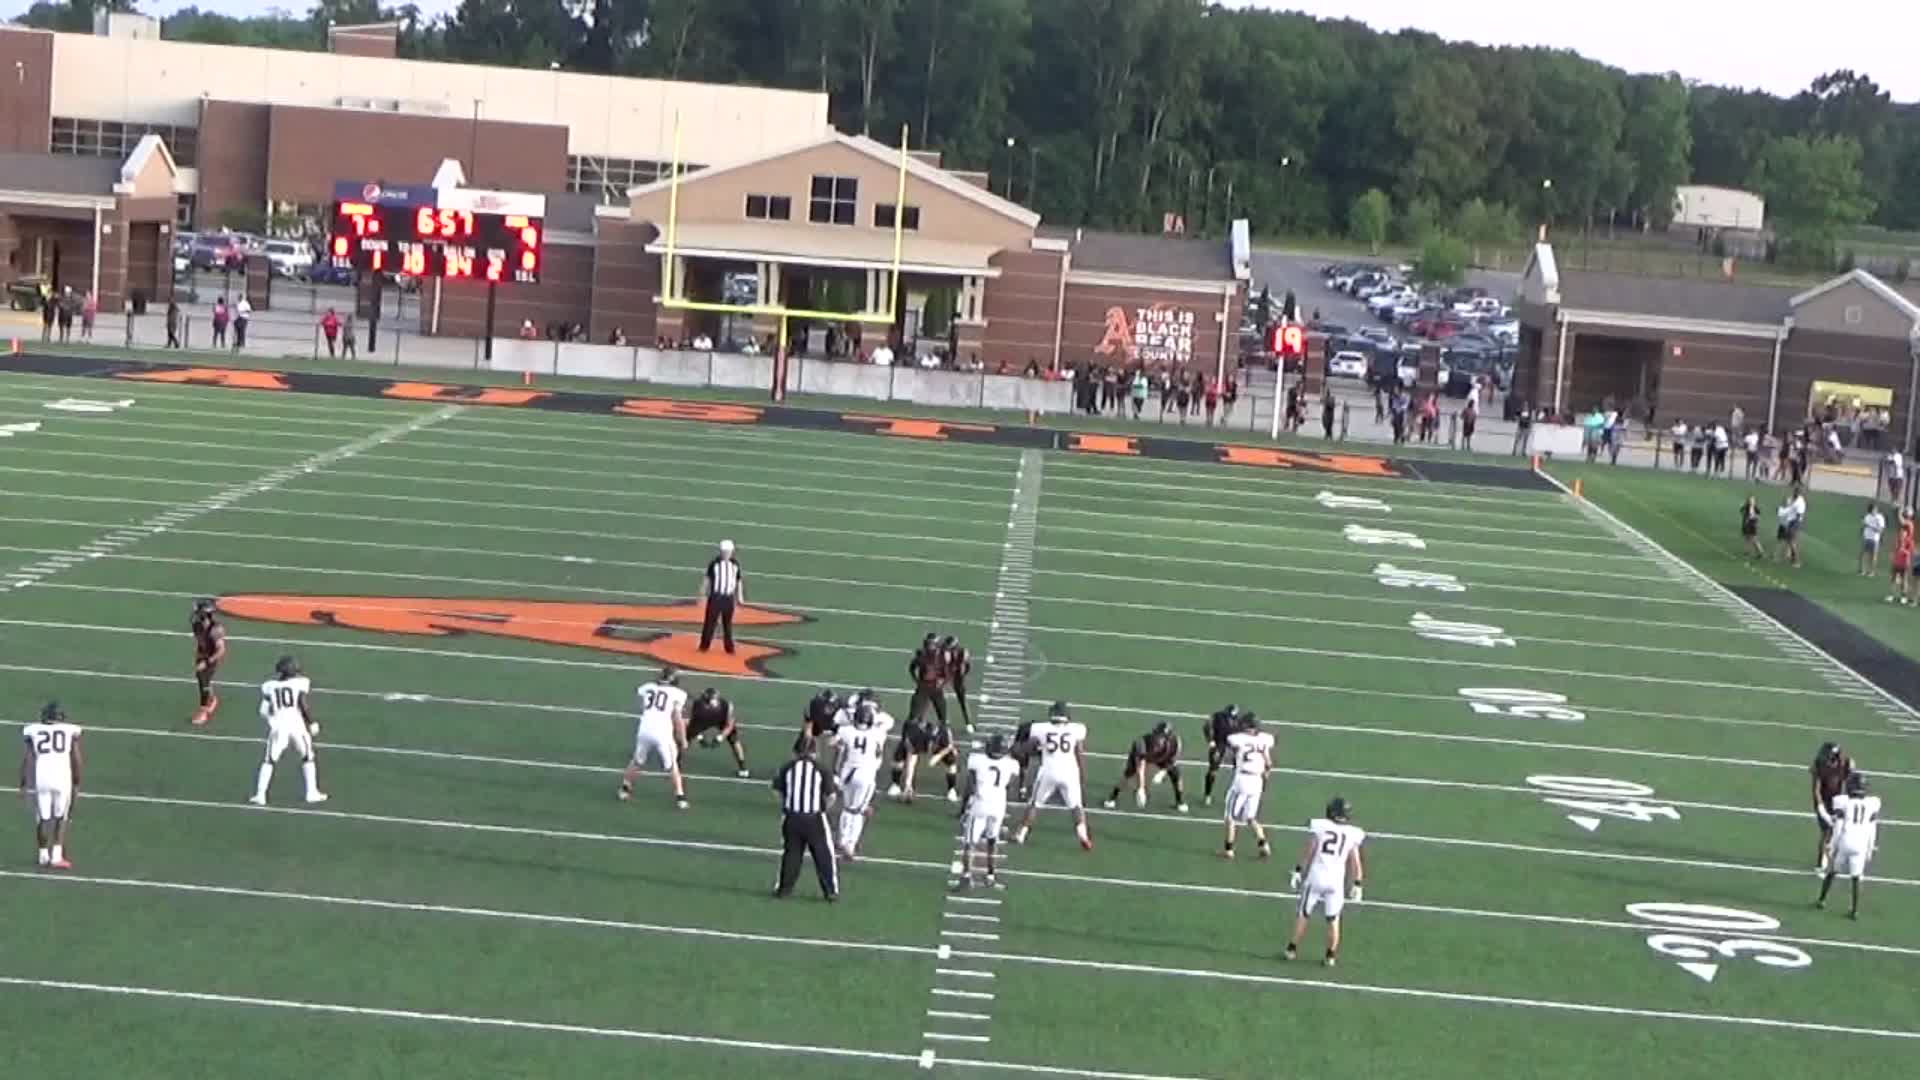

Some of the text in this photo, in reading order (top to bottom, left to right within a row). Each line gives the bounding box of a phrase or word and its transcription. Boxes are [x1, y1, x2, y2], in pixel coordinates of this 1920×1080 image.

[417, 207, 473, 235] 6:57
[1136, 308, 1194, 324] THIS IS
[1135, 320, 1192, 337] BLACK
[1275, 327, 1301, 353] 19
[274, 686, 294, 708] 10
[645, 689, 668, 712] 30
[37, 730, 66, 753] 20
[854, 735, 868, 755] 4
[1046, 732, 1071, 753] 56
[988, 765, 1001, 787] 7
[1525, 775, 1682, 822] 40
[1853, 803, 1866, 825] 11
[1321, 830, 1347, 857] 21
[1625, 902, 1813, 967] 30
